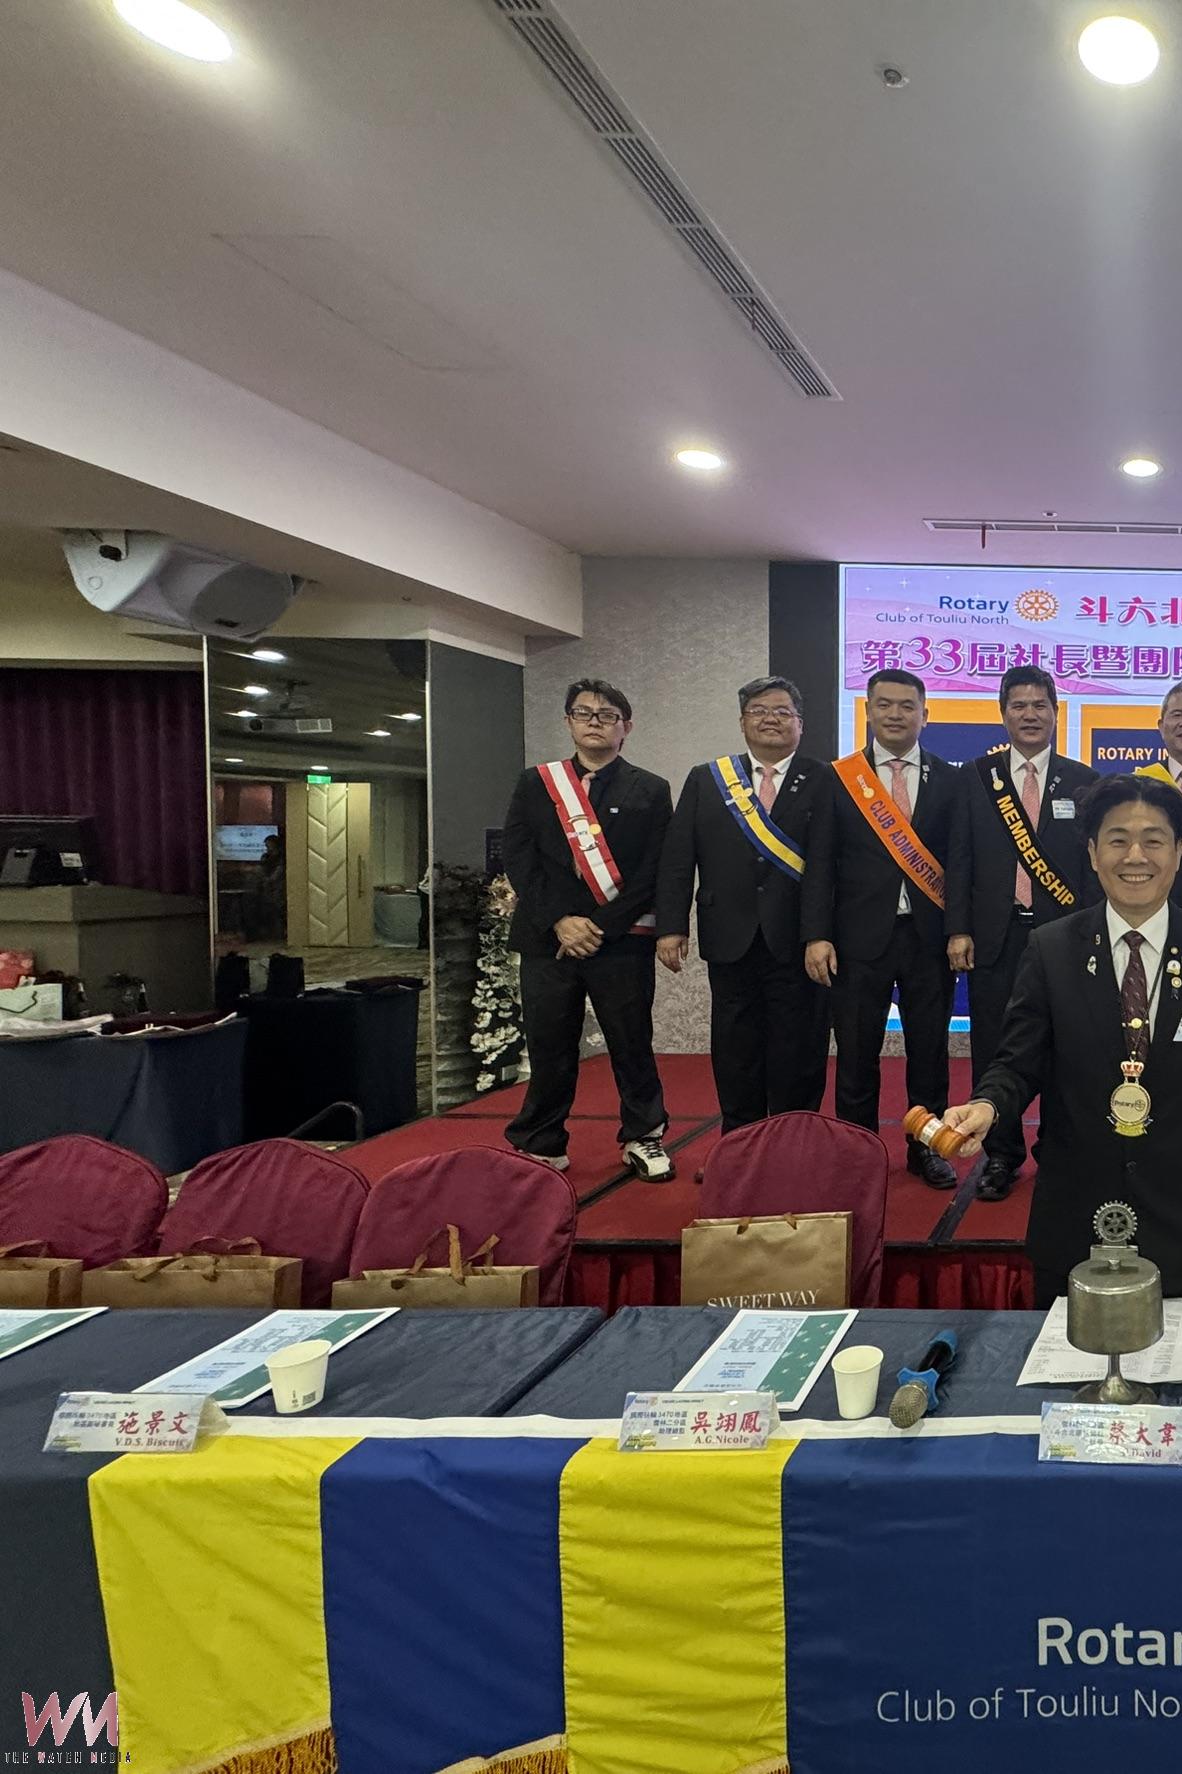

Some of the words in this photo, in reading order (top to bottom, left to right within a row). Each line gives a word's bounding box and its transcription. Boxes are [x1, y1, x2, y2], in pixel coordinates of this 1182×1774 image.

[939, 596, 1009, 613] Rotary
[876, 612, 906, 623] Club
[909, 612, 924, 623] of
[927, 613, 968, 624] Touliu
[971, 614, 1009, 625] North
[1097, 746, 1154, 762] ROTARY
[869, 799, 897, 830] CLUB
[996, 794, 1076, 907] MEMBERSHIP
[779, 1288, 820, 1307] WAY
[115, 1437, 144, 1447] V.D.S.
[877, 1689, 956, 1723] Club
[968, 1687, 1005, 1720] of
[1015, 1685, 1120, 1718] Touliu
